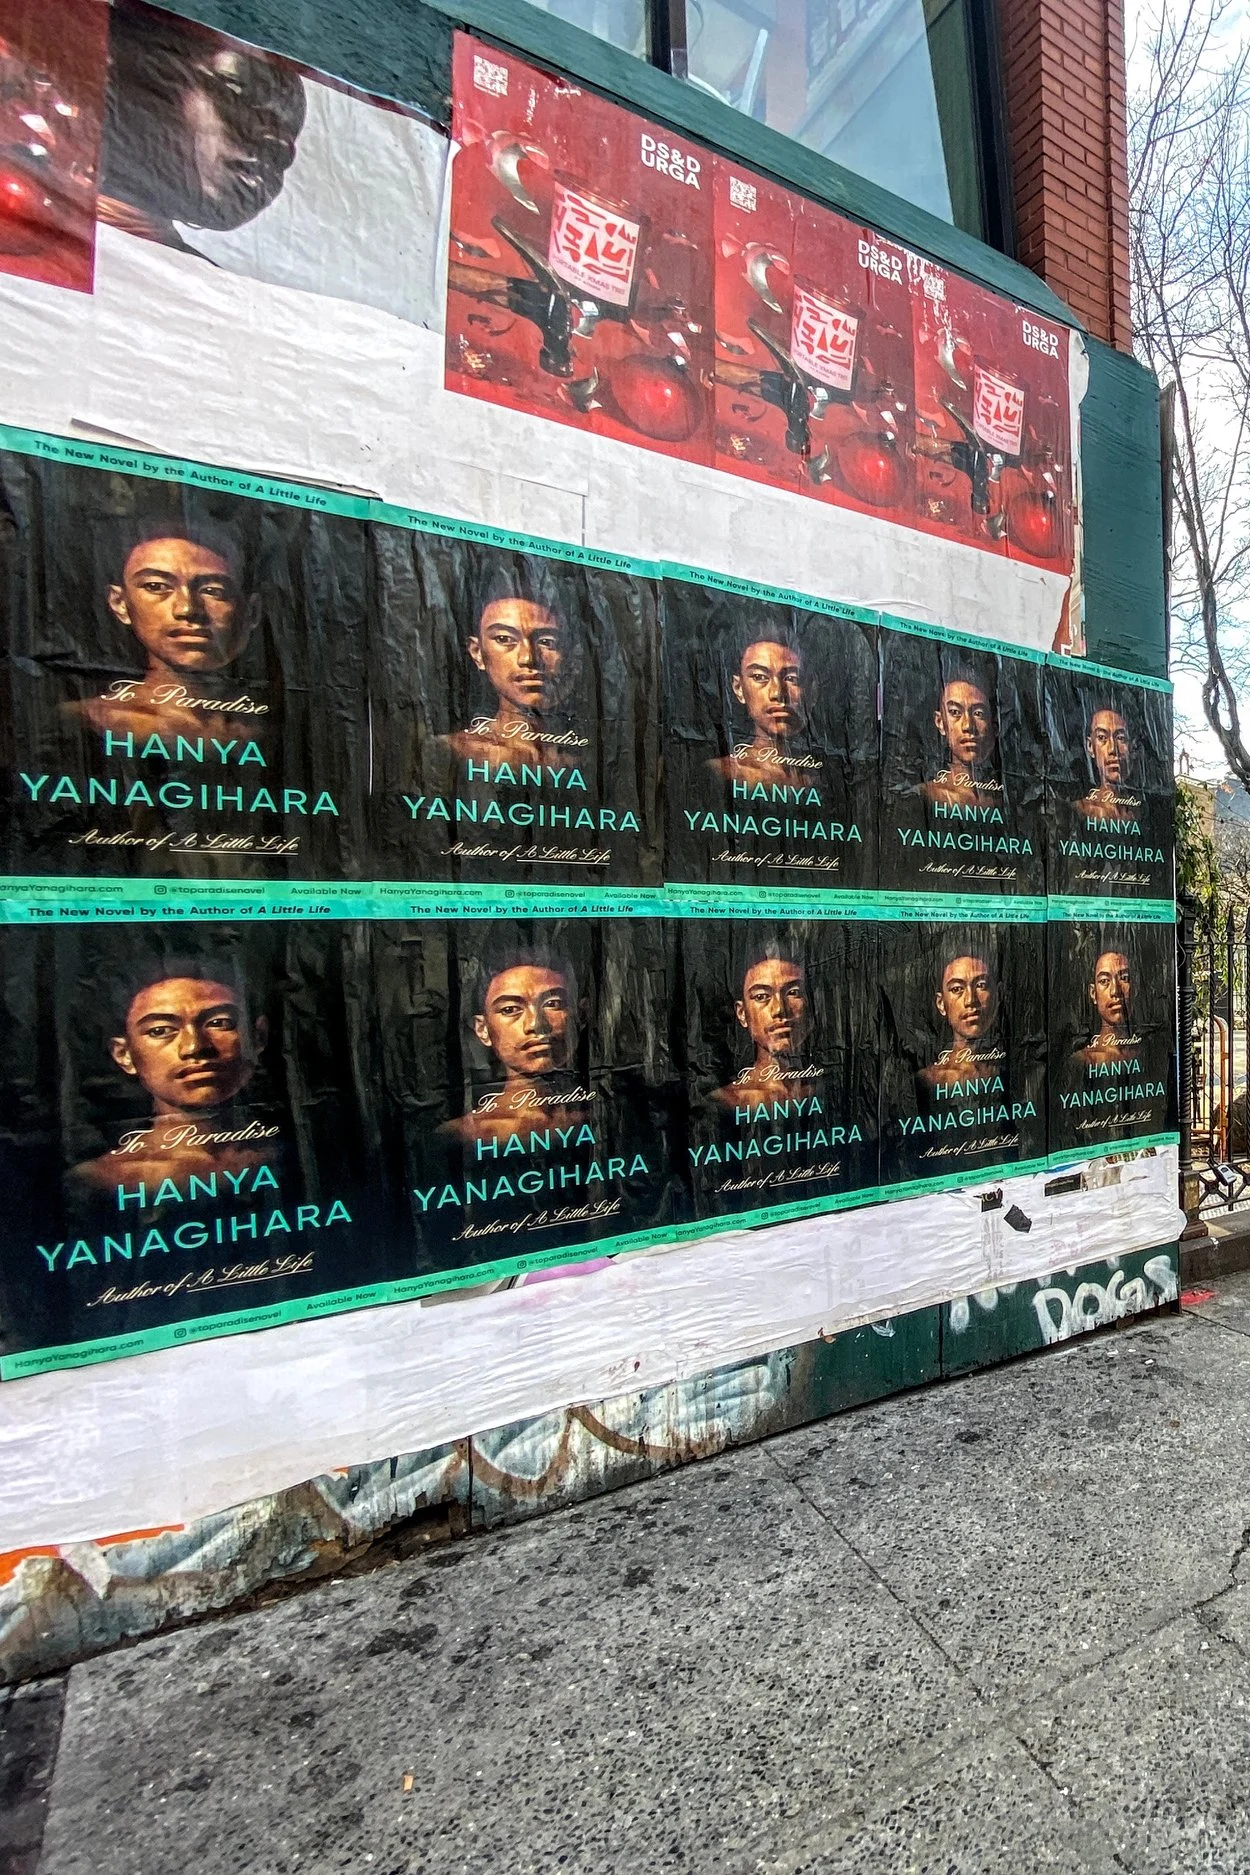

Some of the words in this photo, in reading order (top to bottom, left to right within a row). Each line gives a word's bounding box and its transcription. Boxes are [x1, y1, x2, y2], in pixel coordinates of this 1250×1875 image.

[641, 133, 701, 173] DS&D
[641, 149, 701, 191] URGA
[858, 239, 902, 271] DS&D
[858, 253, 903, 285] URGA
[1022, 320, 1058, 347] DS&D
[1023, 333, 1059, 360] URGA
[34, 441, 59, 454] The
[65, 448, 94, 461] New
[100, 455, 137, 469] Novel
[143, 463, 158, 475] by
[164, 467, 185, 479] the
[190, 471, 234, 489] Author
[239, 482, 251, 492] of
[255, 486, 264, 494] A
[270, 489, 300, 502] Little
[306, 496, 327, 507] Life
[409, 516, 428, 526] The
[432, 521, 455, 533] New
[460, 527, 489, 539] Novel
[493, 533, 505, 544] by
[509, 536, 525, 547] the
[530, 542, 561, 554] Author
[566, 549, 575, 557] of
[588, 554, 612, 565] Little
[616, 560, 631, 569] Life
[101, 679, 146, 702] To
[150, 684, 270, 715] Paradise
[464, 717, 496, 735] To
[501, 720, 589, 747] Paradise
[106, 730, 267, 767] HANYA
[730, 743, 754, 760] To
[757, 747, 823, 769] Paradise
[467, 757, 587, 791] HANYA
[933, 770, 952, 783] To
[953, 773, 1004, 791] Paradise
[20, 773, 339, 816] YANAGIHARA
[732, 780, 821, 807] HANYA
[403, 796, 640, 832] YANAGIHARA
[684, 809, 863, 844] YANAGIHARA
[934, 800, 1003, 824] HANYA
[1086, 816, 1142, 835] HANYA
[69, 829, 143, 846] Author
[145, 832, 176, 851] of
[200, 834, 254, 850] Little
[256, 836, 300, 853] Life
[441, 842, 498, 856] Author
[499, 845, 521, 861] of
[538, 847, 578, 860] Little
[579, 848, 611, 864] Life
[899, 828, 1033, 855] YANAGIHARA
[1059, 840, 1165, 863] YANAGIHARA
[712, 850, 754, 863] Author
[754, 853, 772, 867] of
[785, 854, 814, 866] Little
[815, 856, 840, 869] Life
[0, 883, 124, 896] anyaYanagihara.com
[290, 886, 337, 895] Available
[340, 887, 361, 895] Now
[28, 907, 53, 917] The
[60, 907, 89, 917] New
[96, 906, 134, 916] Novel
[140, 906, 157, 920] by
[162, 906, 184, 916] the
[190, 906, 234, 915] Author
[240, 906, 252, 915] of
[258, 906, 266, 914] A
[272, 905, 303, 914] Little
[309, 905, 330, 914] Life
[411, 906, 430, 914] The
[496, 906, 508, 914] by
[512, 905, 527, 913] the
[532, 905, 564, 913] Author
[568, 905, 577, 913] of
[580, 905, 588, 913] A
[591, 905, 614, 913] Little
[618, 905, 634, 913] Life
[732, 1067, 756, 1085] To
[758, 1064, 824, 1082] Paradise
[1088, 1058, 1141, 1080] HANYA
[472, 1093, 505, 1114] To
[509, 1086, 596, 1109] Paradise
[936, 1075, 1004, 1101] HANYA
[1060, 1081, 1165, 1110] YANAGIHARA
[735, 1097, 823, 1125] HANYA
[899, 1101, 1036, 1134] YANAGIHARA
[111, 1130, 154, 1155] To
[160, 1120, 279, 1149] Paradise
[477, 1124, 595, 1160] HANYA
[688, 1125, 863, 1167] YANAGIHARA
[118, 1166, 279, 1210] HANYA
[414, 1154, 648, 1211] YANAGIHARA
[452, 1219, 509, 1240] Author
[510, 1213, 532, 1233] of
[549, 1204, 590, 1222] Little
[590, 1197, 620, 1215] Life
[37, 1200, 352, 1271] YANAGIHARA
[86, 1281, 162, 1306] Author
[163, 1272, 193, 1296] of
[216, 1259, 270, 1282] Little
[271, 1252, 314, 1273] Life
[306, 1295, 355, 1311] Available
[357, 1289, 377, 1301] Now
